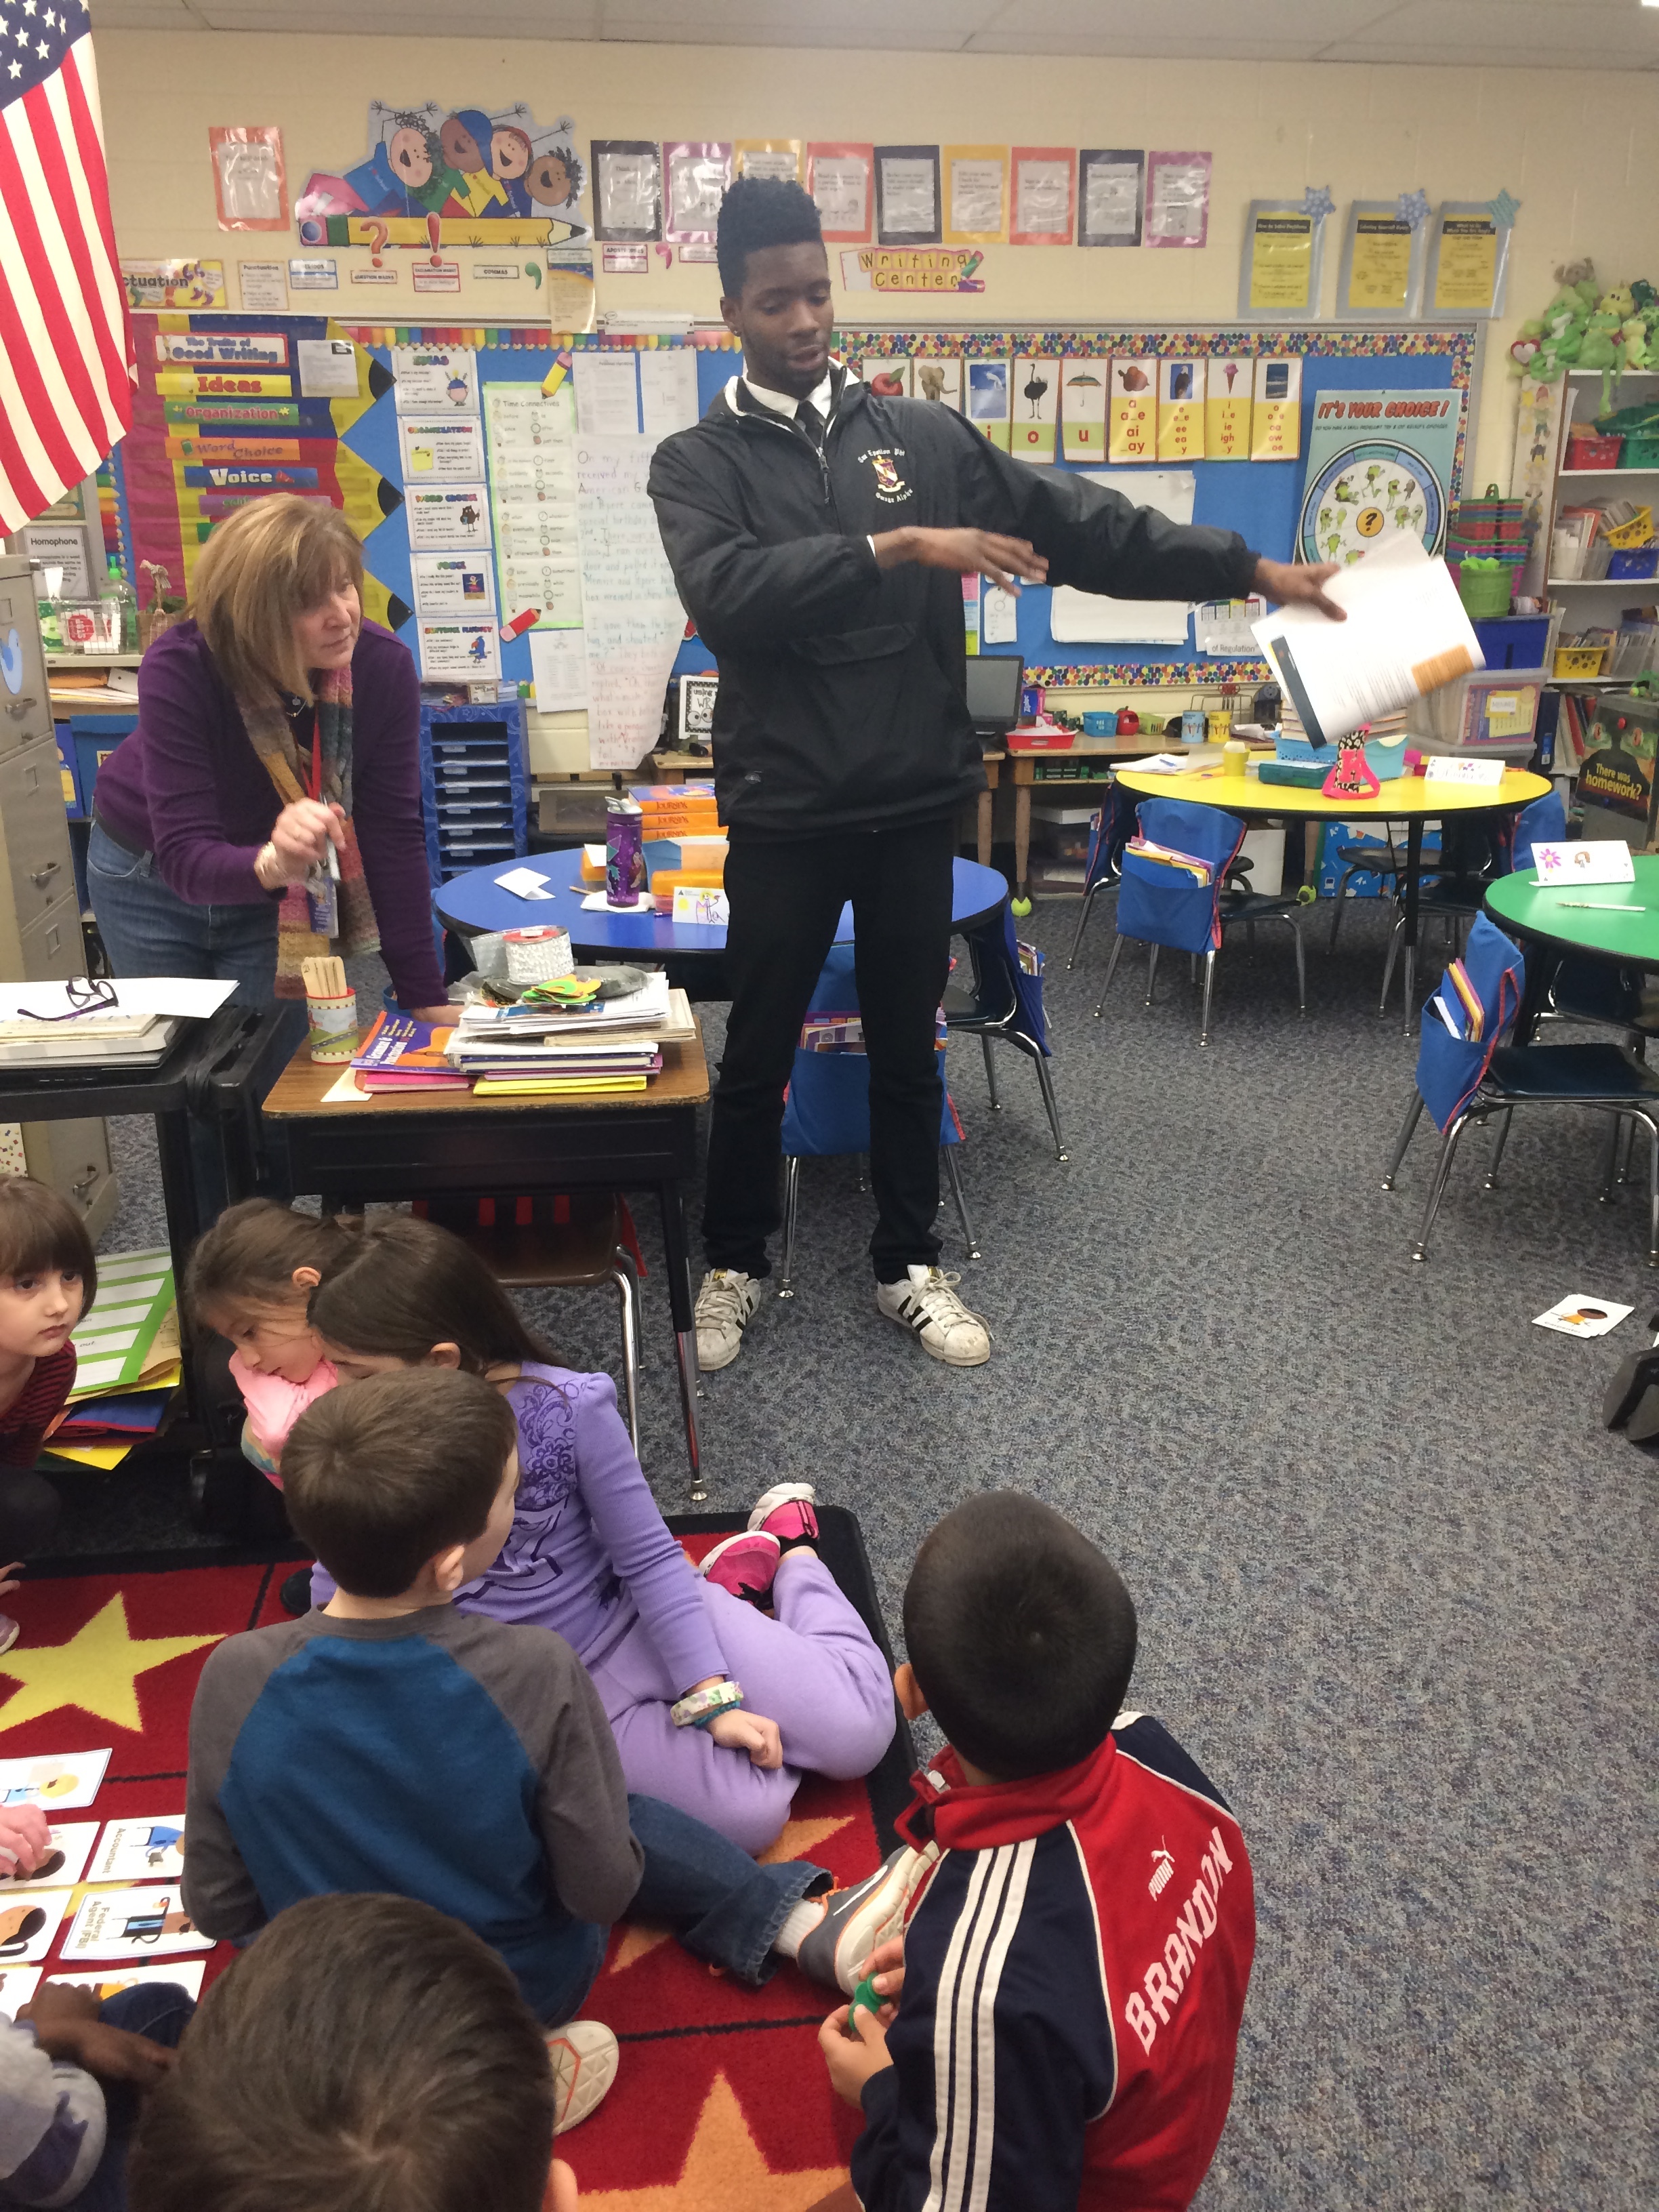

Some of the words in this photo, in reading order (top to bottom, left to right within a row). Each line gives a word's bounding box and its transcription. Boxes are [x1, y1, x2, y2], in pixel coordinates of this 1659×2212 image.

[861, 253, 967, 269] Writing
[123, 274, 189, 287] ctuation
[875, 272, 958, 287] Center
[186, 337, 205, 346] The
[239, 337, 251, 347] of
[172, 346, 214, 359] Good
[218, 347, 278, 363] Writing
[412, 355, 449, 366] IDEAS
[197, 376, 262, 393] Ideas
[1128, 399, 1136, 408] a
[1317, 400, 1347, 419] IT'S
[1348, 401, 1383, 418] YOUR
[185, 406, 279, 422] Organization
[407, 426, 472, 434] ORGANIZATION
[986, 424, 991, 442] i
[1126, 425, 1139, 437] ai
[1224, 422, 1232, 430] ie
[1027, 430, 1039, 444] o
[1078, 429, 1089, 443] u
[1221, 432, 1235, 444] igh
[196, 440, 235, 453] Word
[232, 445, 283, 459] Choice
[867, 448, 891, 457] Epsilon
[577, 451, 594, 464] On
[209, 468, 272, 486] Voice
[577, 466, 617, 479] received
[578, 482, 629, 495] American
[896, 488, 914, 502] Alpha
[415, 494, 443, 503] WORD
[30, 537, 78, 547] Homophone
[436, 560, 467, 570] VOICE
[1220, 644, 1255, 654] Regulation
[1596, 762, 1616, 779] There
[1617, 771, 1631, 783] was
[1586, 769, 1642, 801] homework?
[657, 801, 688, 811] JOURNEYS
[657, 815, 689, 825] JOURNEYS
[102, 1828, 127, 1874] Accountant
[1148, 1858, 1174, 1902] PUMA
[85, 1900, 102, 1927] Agent
[89, 1907, 110, 1942] Federal
[1125, 1826, 1233, 2057] BRANDON
